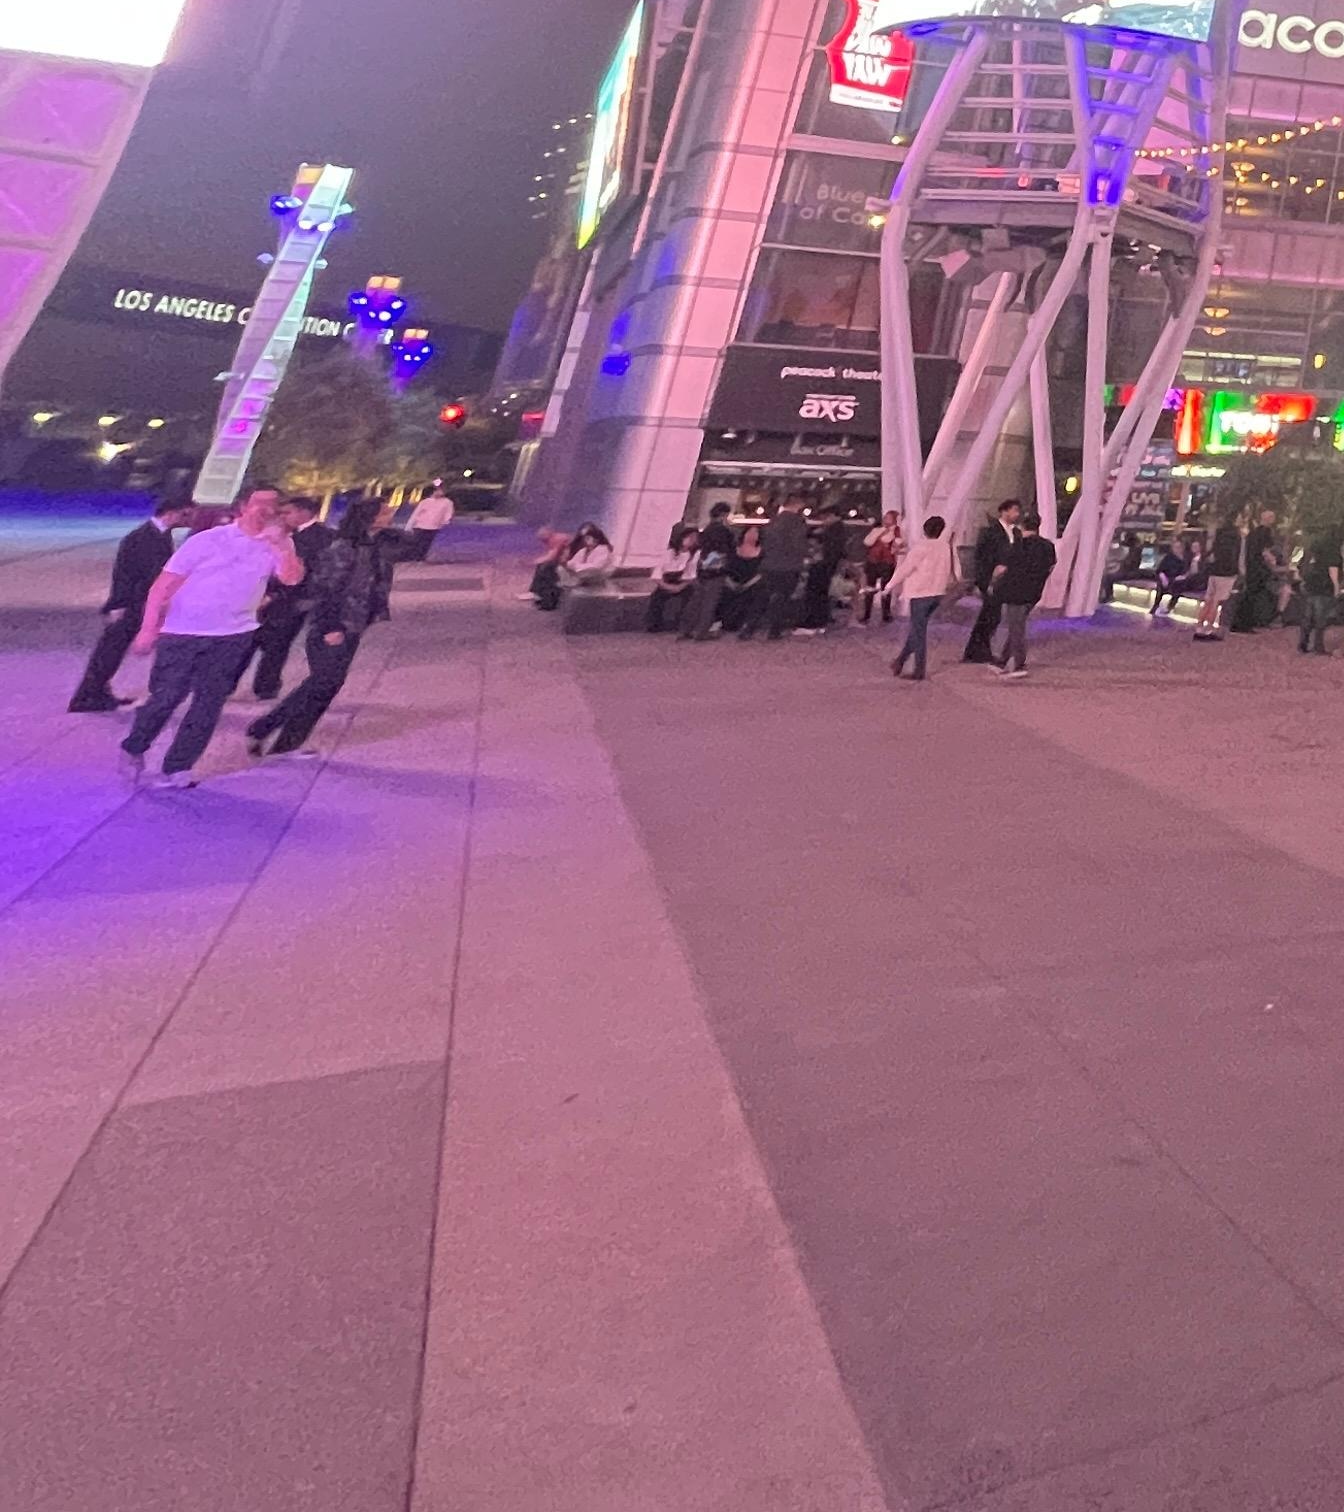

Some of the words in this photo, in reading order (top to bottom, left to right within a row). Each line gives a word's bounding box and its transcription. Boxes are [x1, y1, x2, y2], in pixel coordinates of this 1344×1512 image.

[113, 288, 153, 311] LOS
[154, 295, 236, 323] ANGELES
[237, 307, 341, 337] CTION
[799, 394, 860, 422] axs
